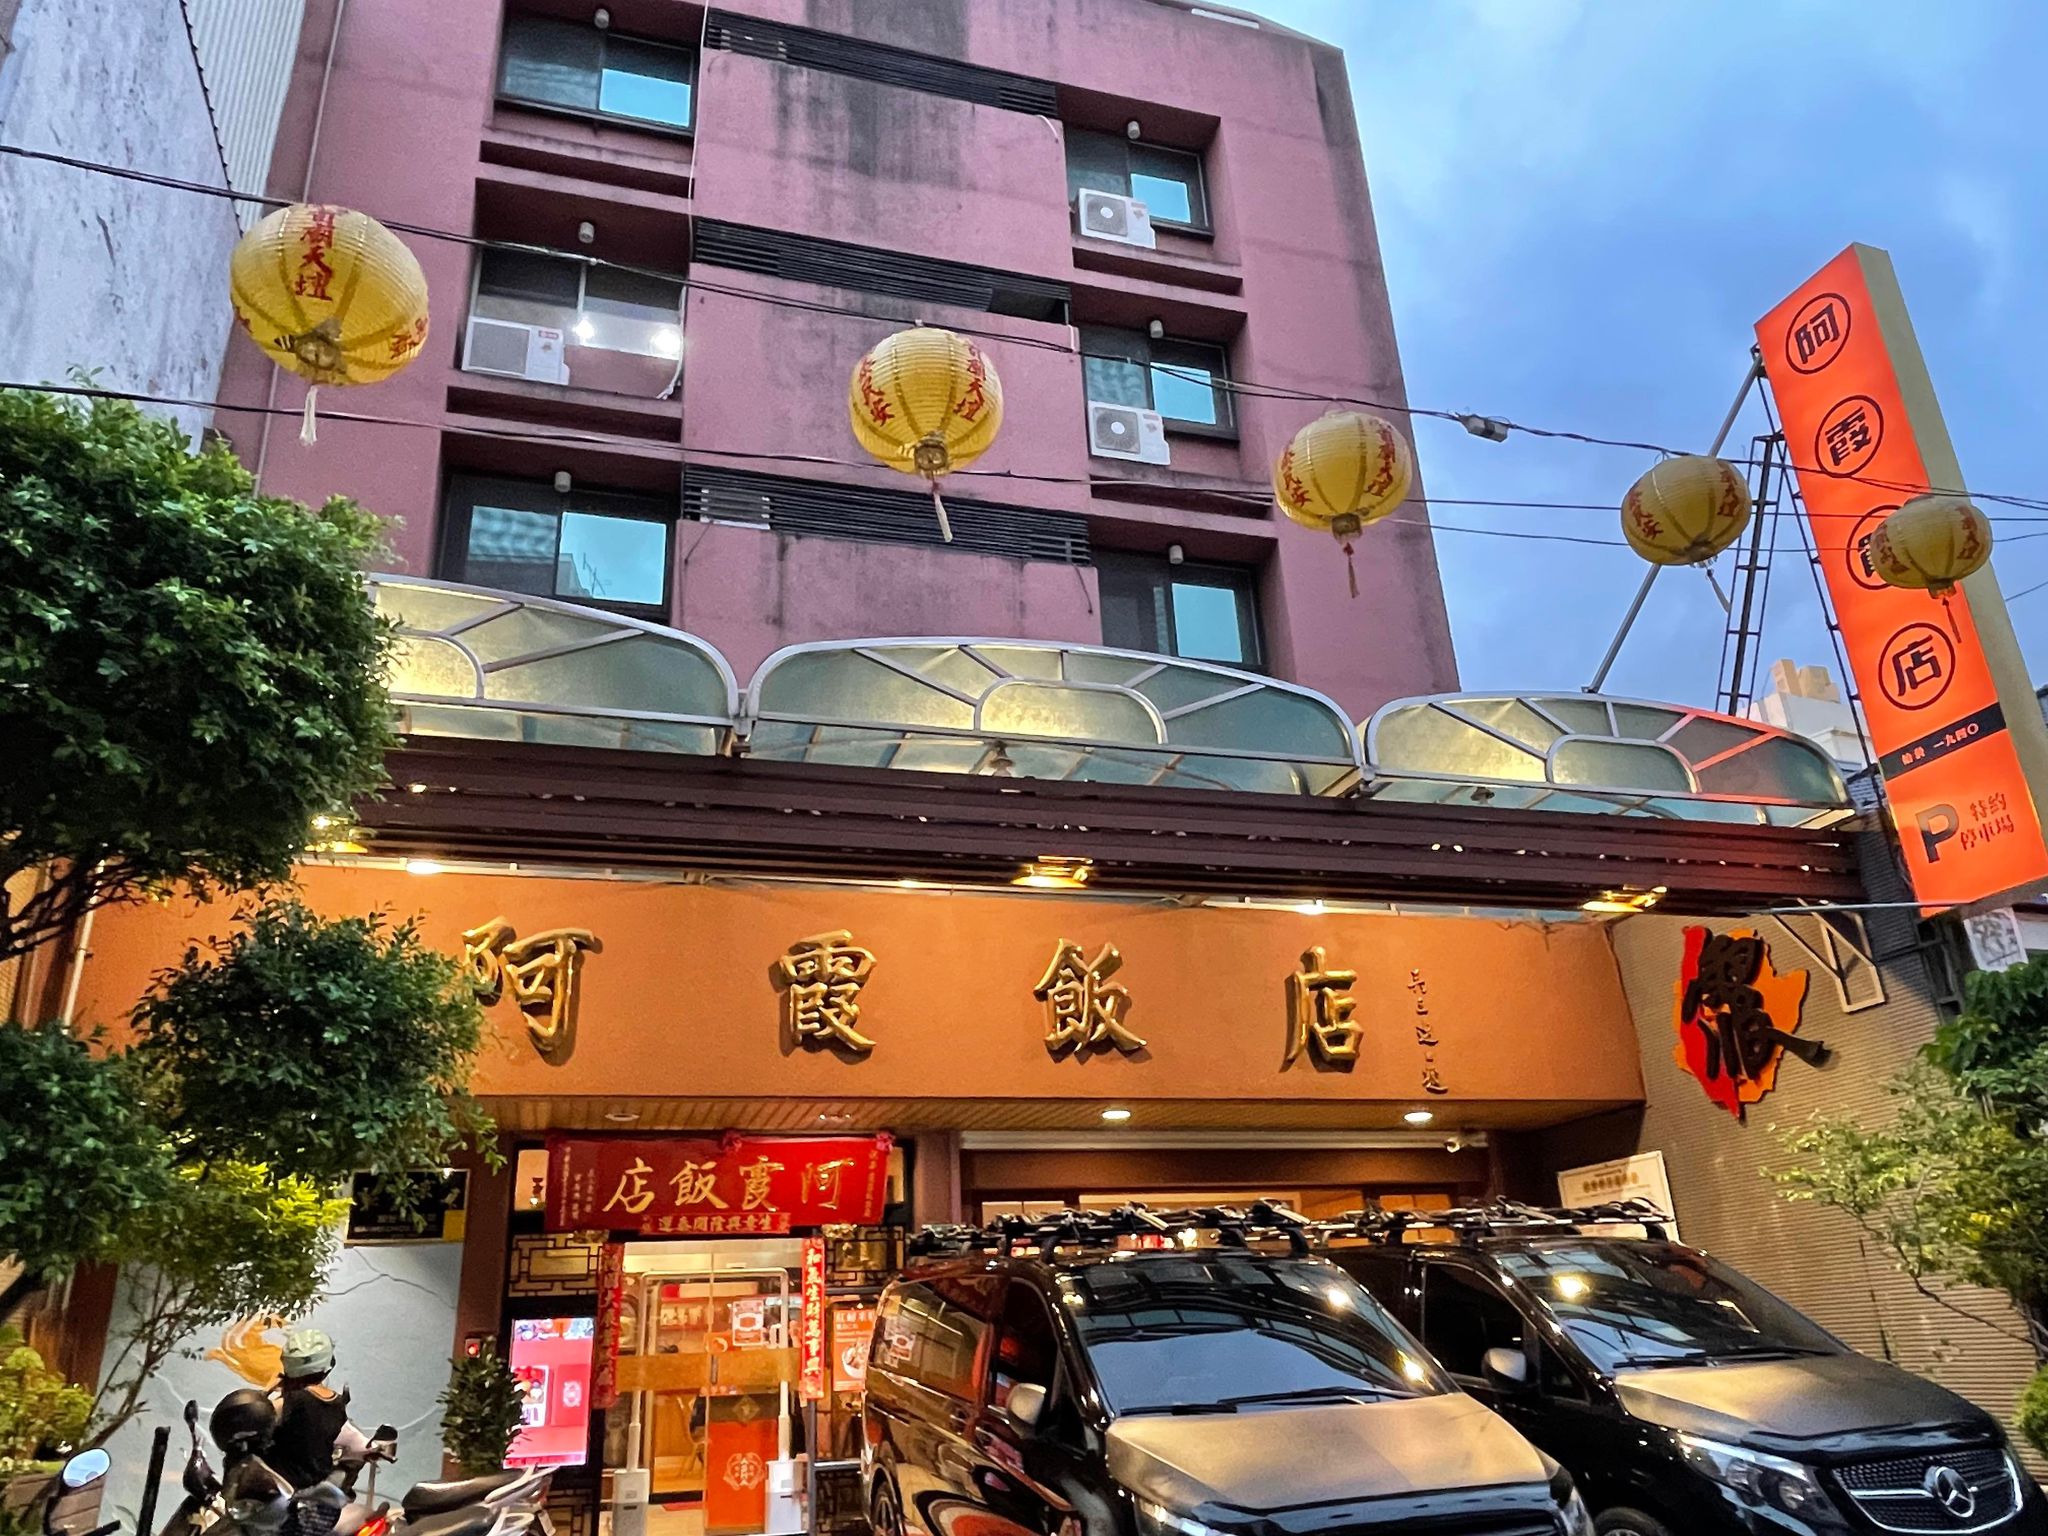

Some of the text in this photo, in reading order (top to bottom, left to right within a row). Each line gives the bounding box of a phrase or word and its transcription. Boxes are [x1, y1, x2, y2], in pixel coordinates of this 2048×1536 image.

[1794, 303, 1942, 696] 阿霞店
[1915, 803, 1960, 864] P
[461, 915, 1364, 1066] 阿霞飯店
